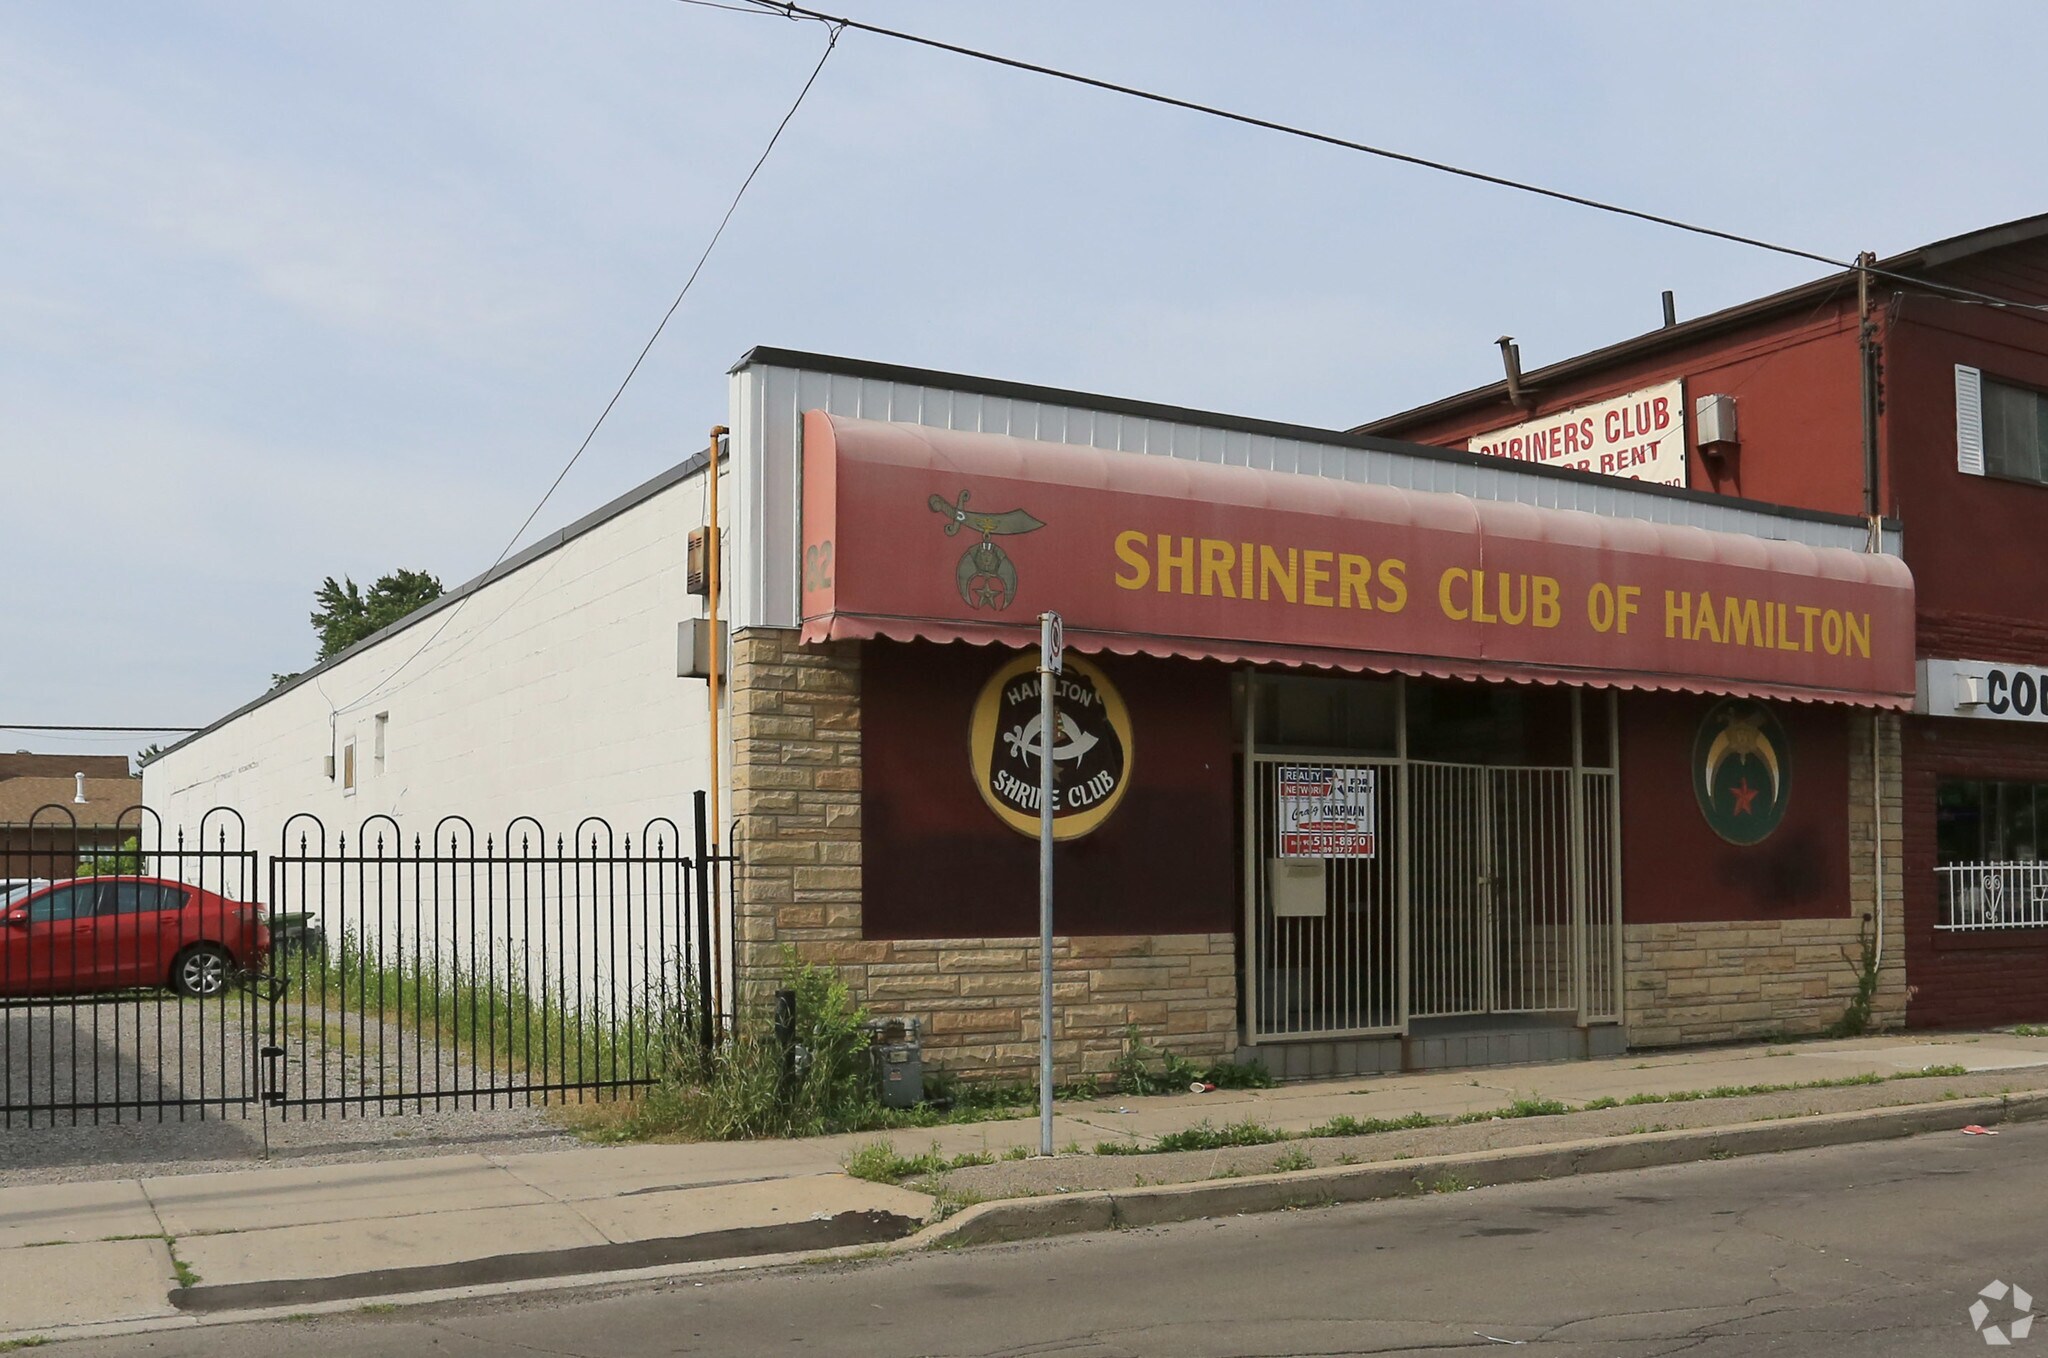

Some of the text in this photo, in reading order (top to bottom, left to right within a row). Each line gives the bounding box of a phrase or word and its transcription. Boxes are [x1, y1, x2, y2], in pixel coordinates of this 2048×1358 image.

[1605, 396, 1670, 443] CLUB
[1600, 440, 1662, 474] RENT
[806, 540, 832, 592] 82
[1114, 530, 1871, 659] SHRINERS CLUB OF HAMILTON
[1007, 678, 1093, 708] HAMLTON
[1068, 769, 1114, 808] CLUB
[1286, 771, 1321, 781] REALTY
